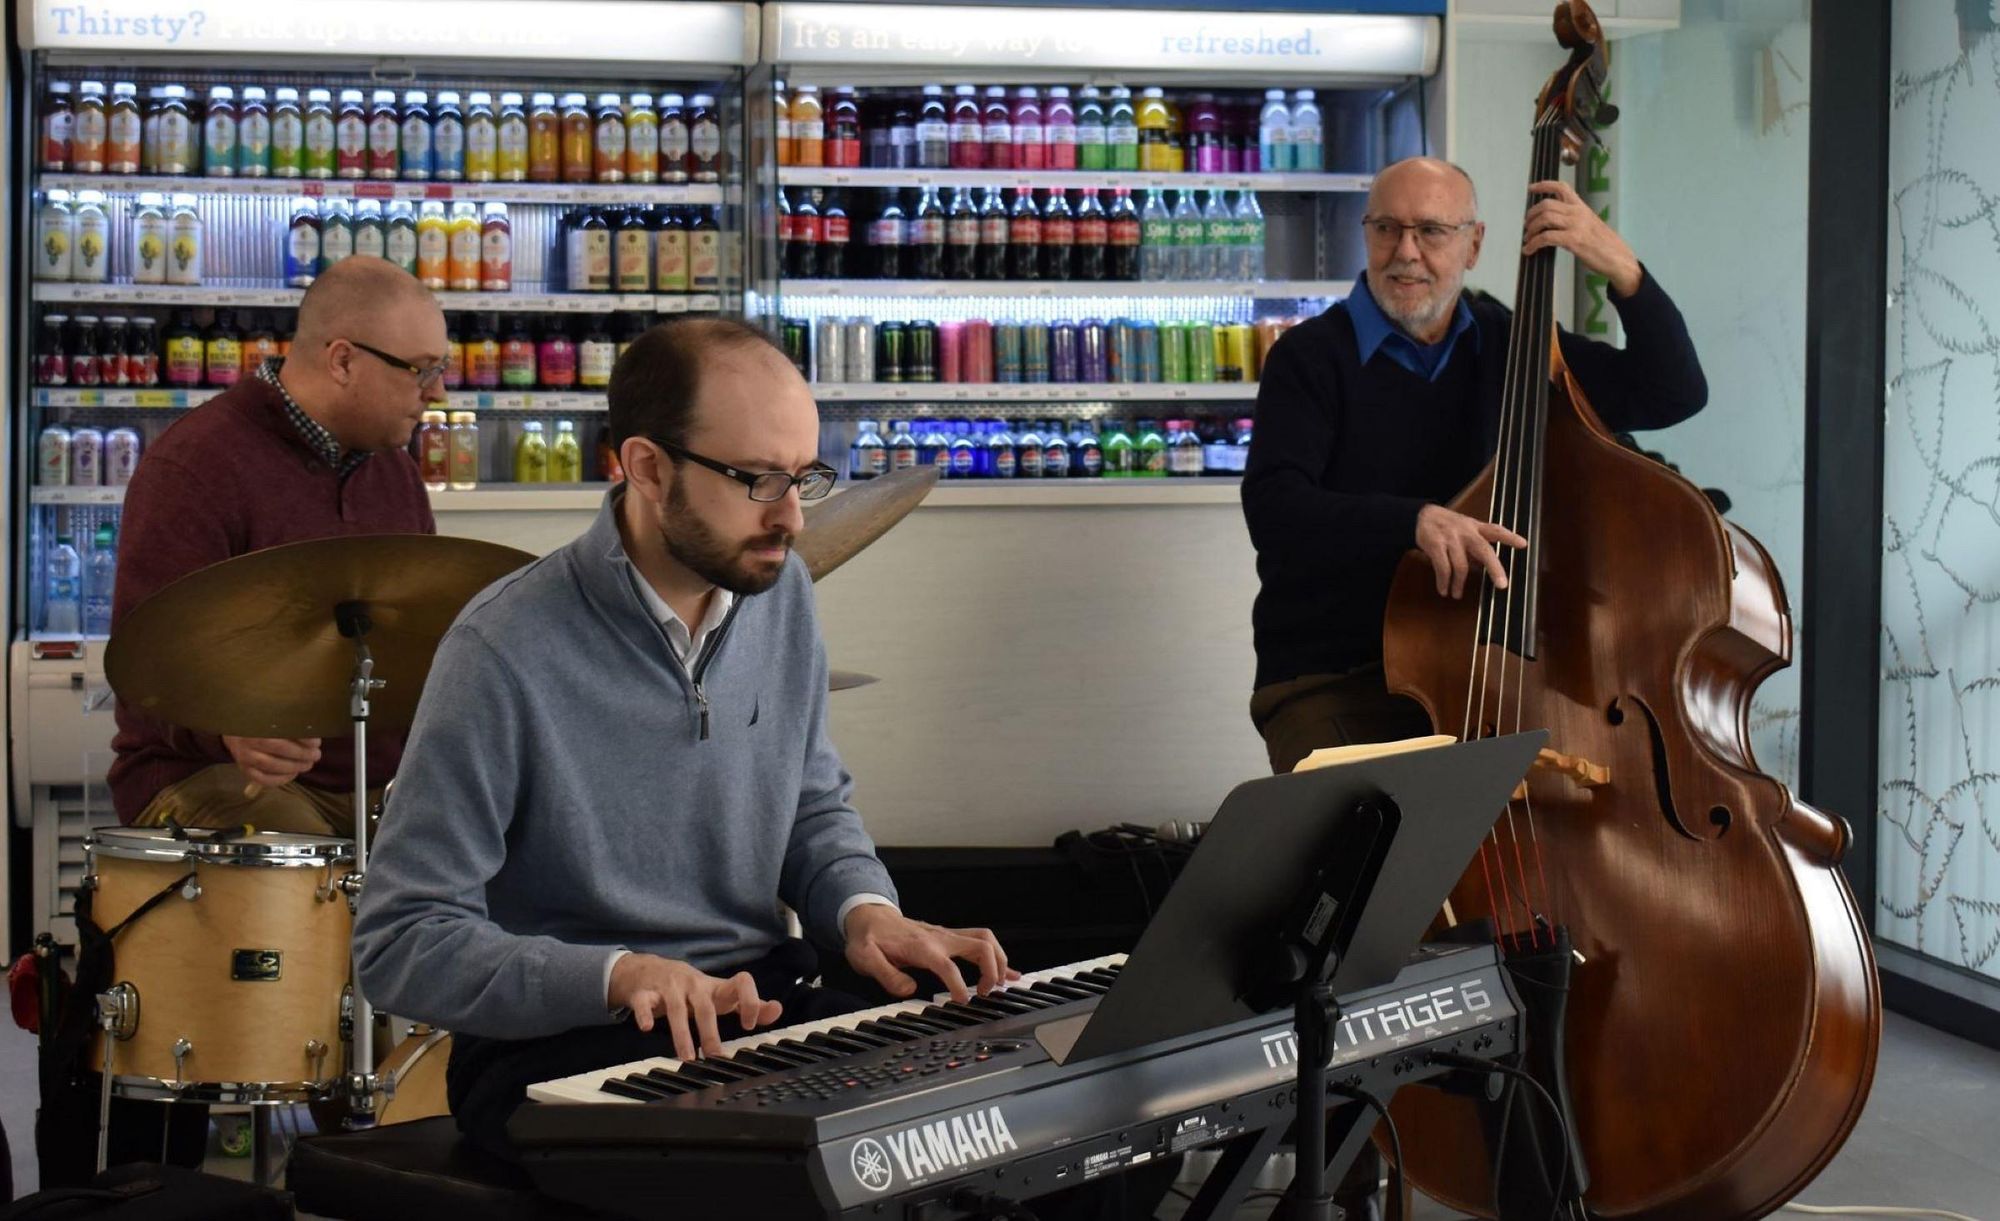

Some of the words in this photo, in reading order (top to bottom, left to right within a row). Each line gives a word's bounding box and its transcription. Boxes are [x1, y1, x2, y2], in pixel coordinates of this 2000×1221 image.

[50, 6, 207, 43] Thirsty?
[794, 19, 841, 48] It's
[852, 28, 889, 50] an
[983, 32, 1044, 58] way
[1160, 25, 1322, 57] refreshed.
[1260, 985, 1463, 1069] MTAGE
[1459, 978, 1491, 1013] 6
[886, 1105, 1018, 1181] YAMAHA
